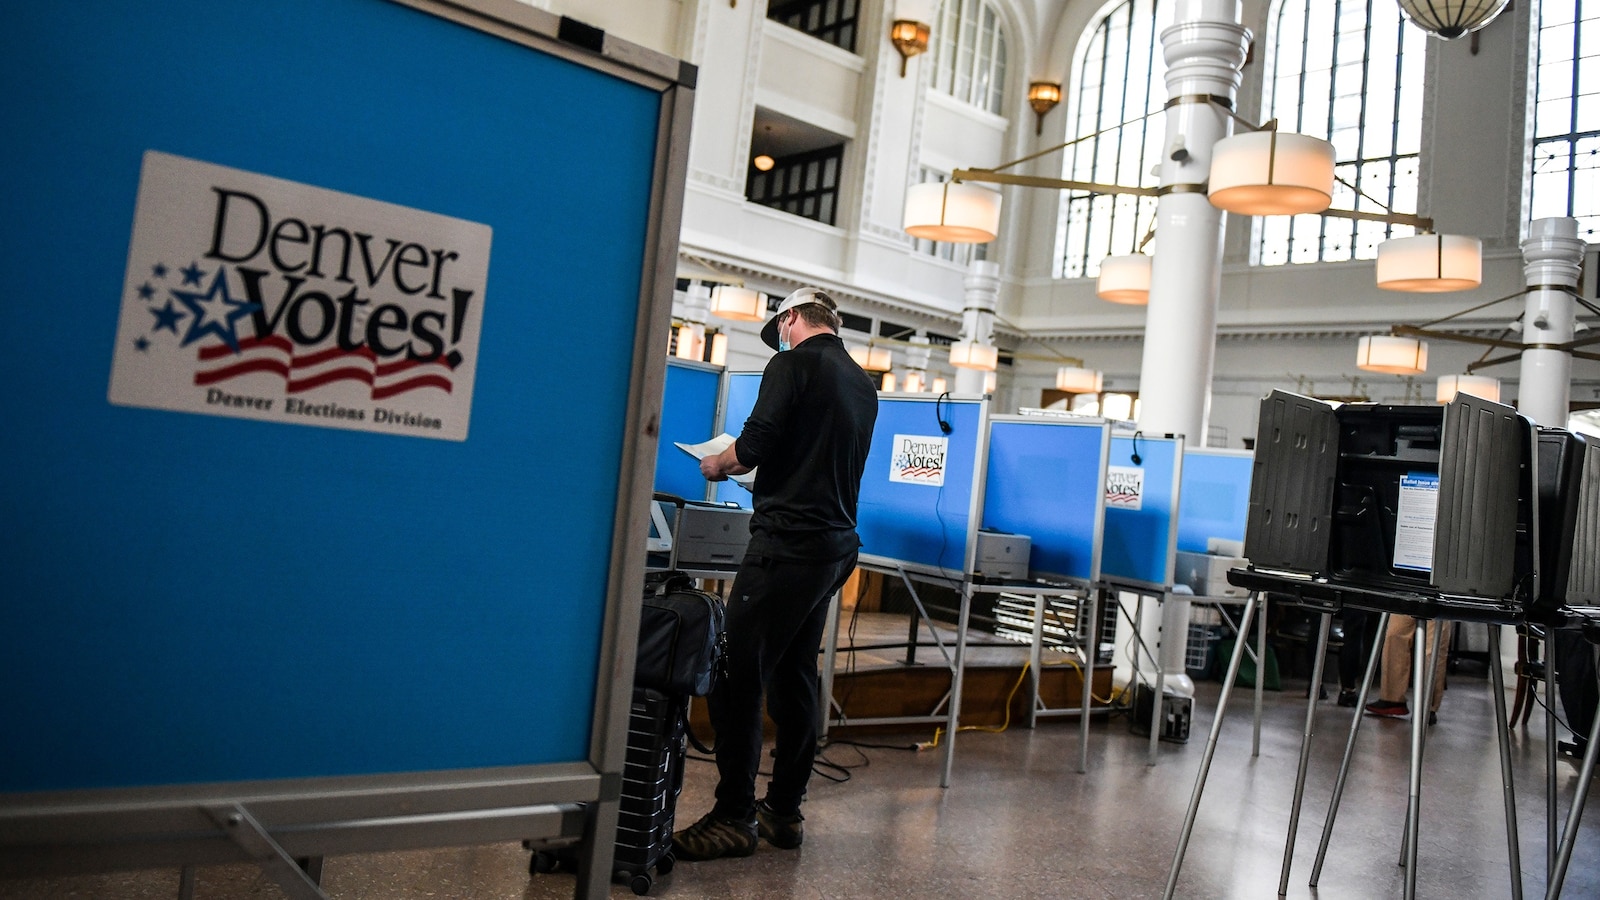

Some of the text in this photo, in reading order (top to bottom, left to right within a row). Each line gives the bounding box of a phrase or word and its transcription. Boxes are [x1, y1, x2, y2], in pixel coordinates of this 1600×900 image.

[204, 186, 460, 299] Denver
[238, 266, 475, 369] Votes!
[206, 387, 443, 430] Denver Elections Division
[902, 439, 942, 456] Denver
[907, 453, 944, 470] Votes!
[1107, 472, 1138, 484] enver
